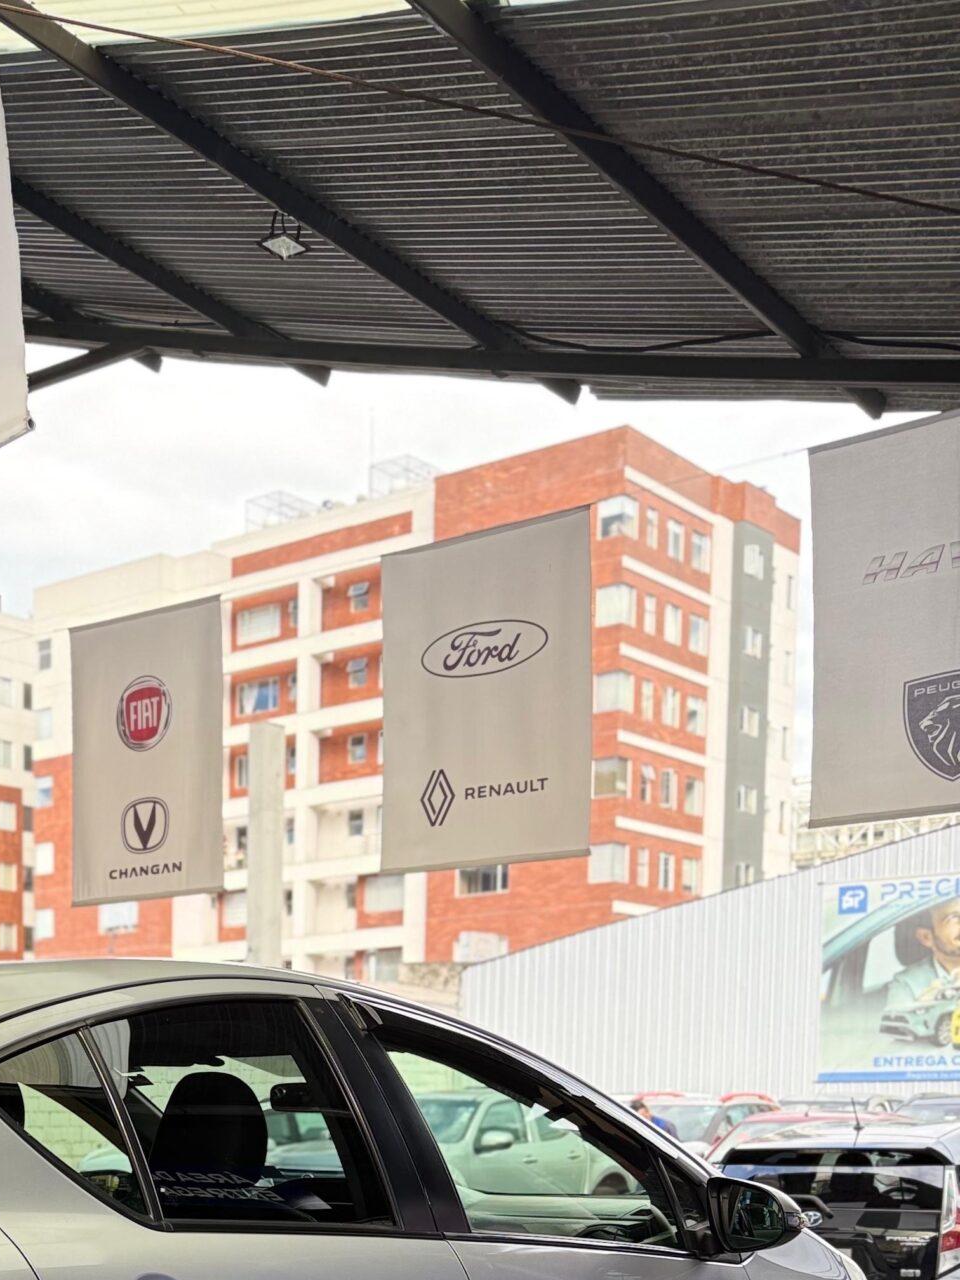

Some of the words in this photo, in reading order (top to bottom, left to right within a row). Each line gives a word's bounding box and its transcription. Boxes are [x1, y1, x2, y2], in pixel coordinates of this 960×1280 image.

[862, 540, 960, 585] HA
[443, 628, 521, 671] Ford
[129, 696, 160, 732] FIAT
[464, 777, 549, 800] RENAULT
[109, 861, 183, 880] CHANGAN
[873, 1054, 949, 1068] ENTREGA
